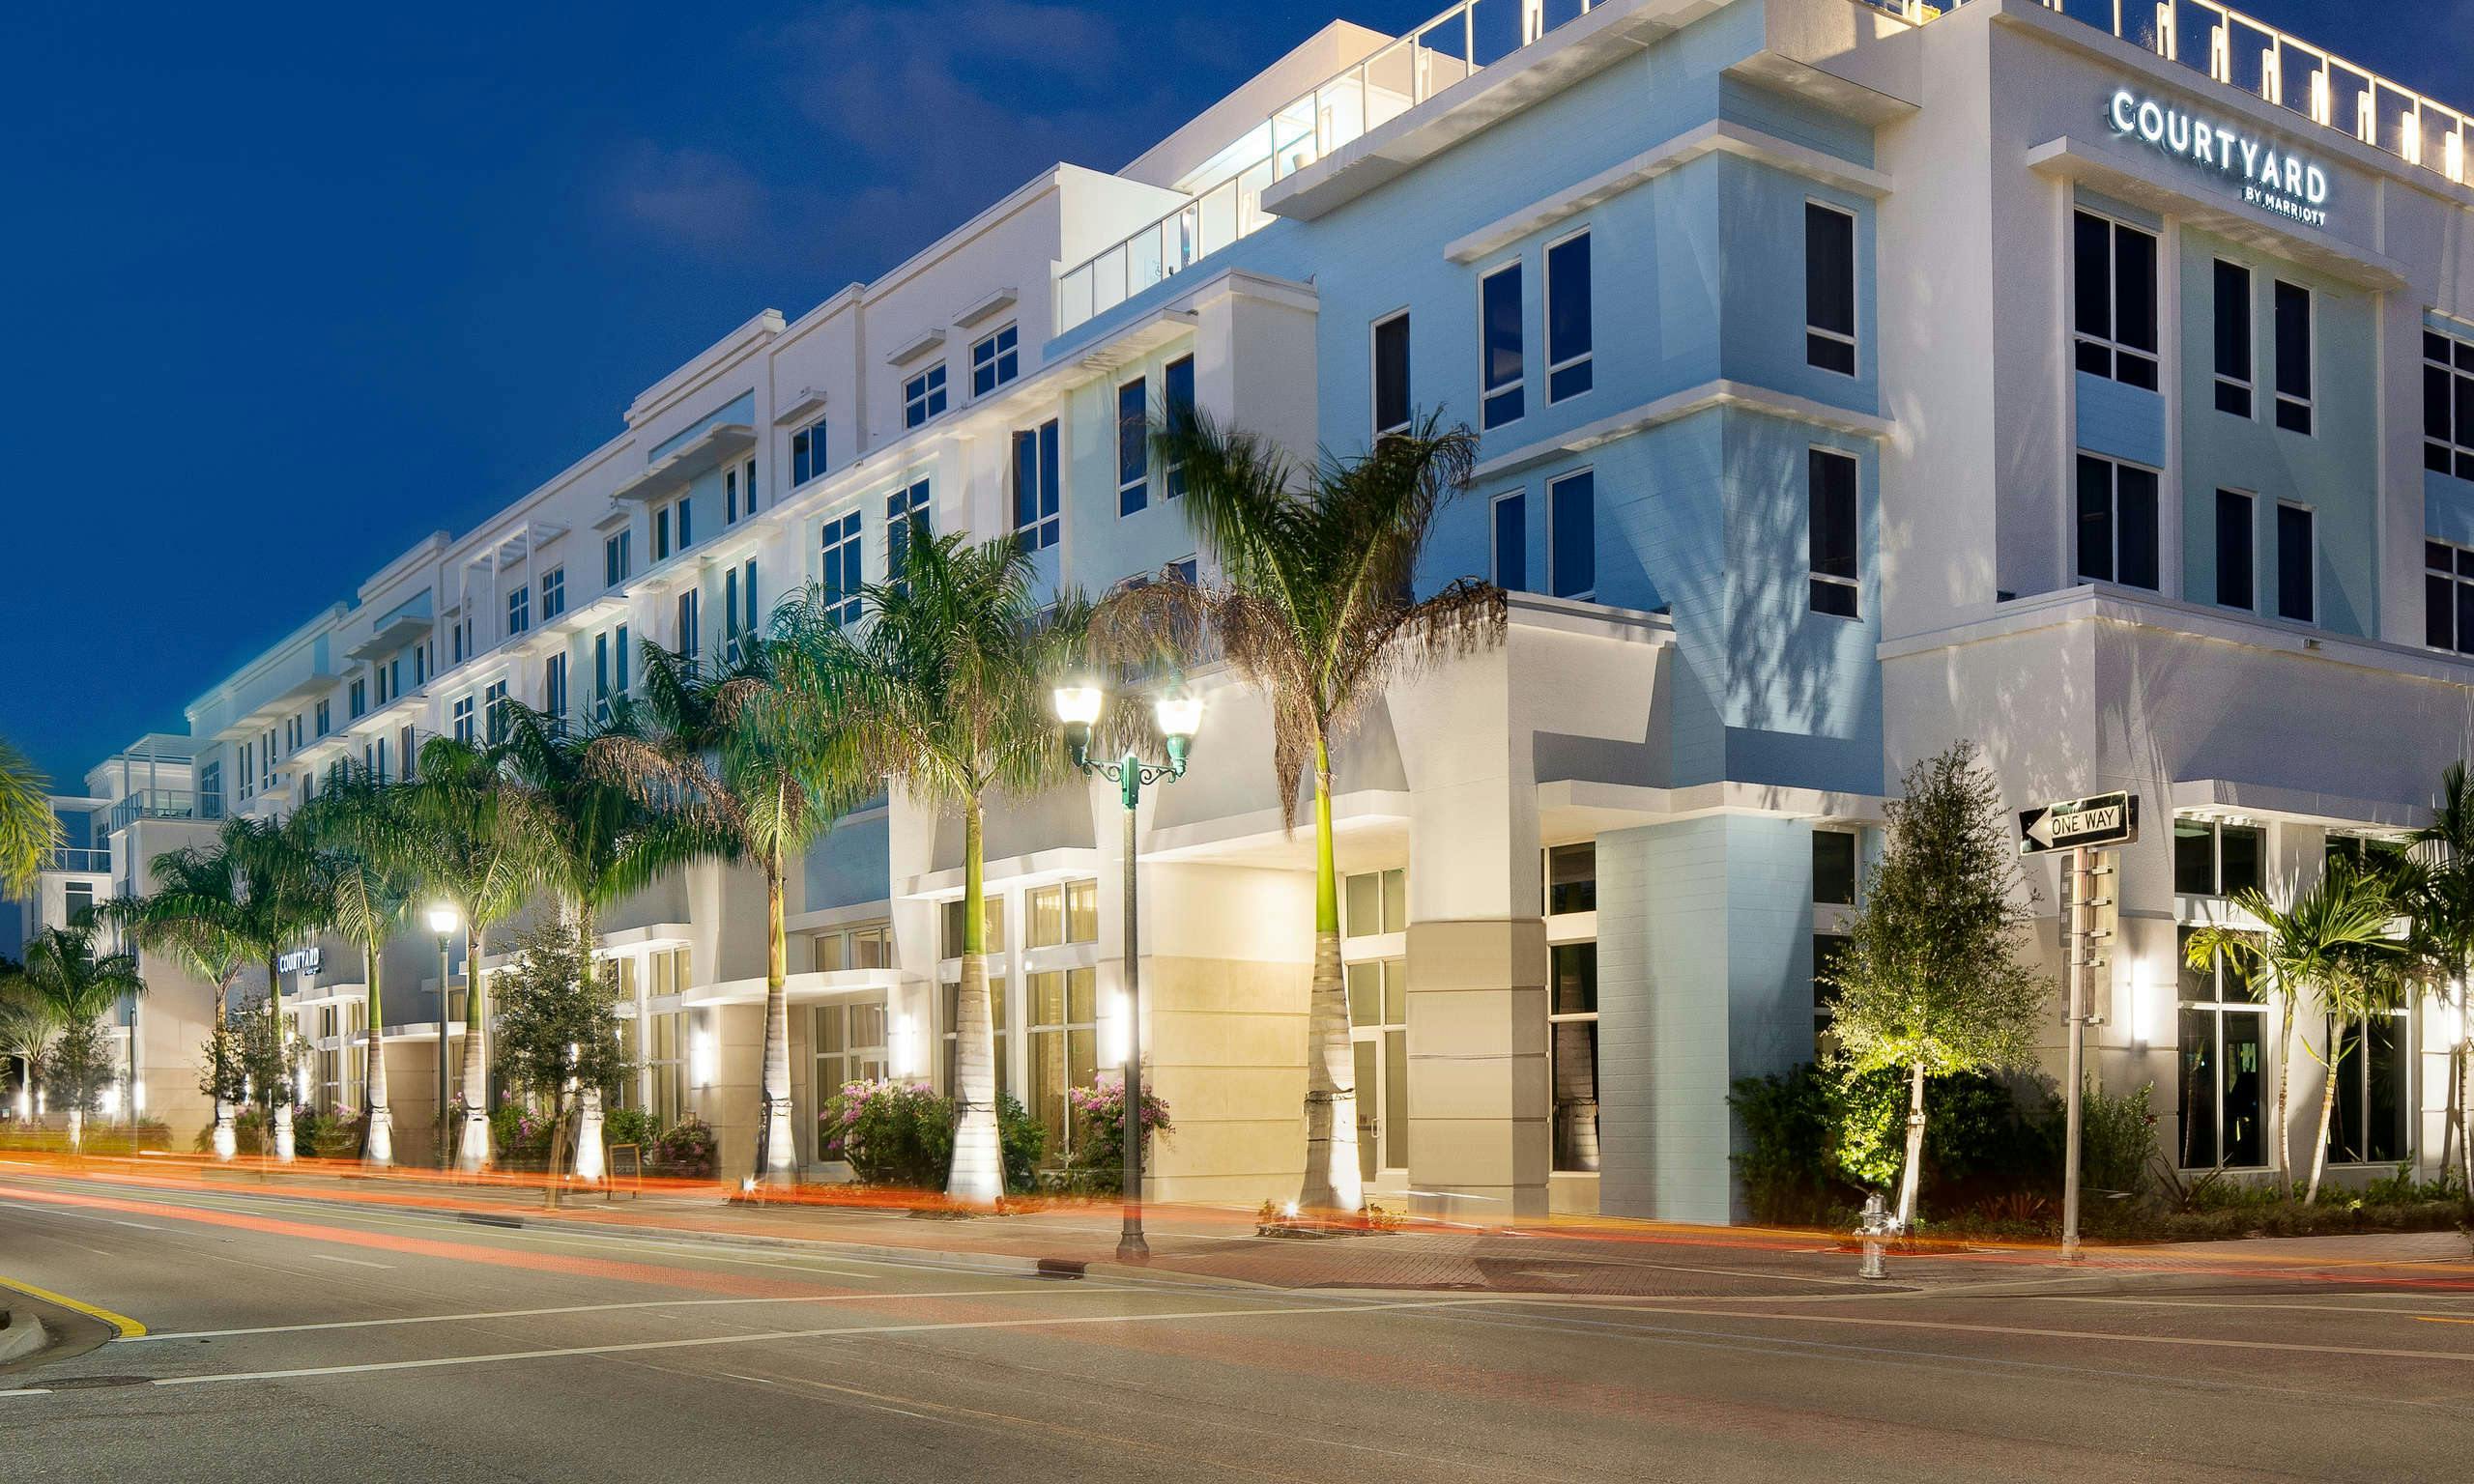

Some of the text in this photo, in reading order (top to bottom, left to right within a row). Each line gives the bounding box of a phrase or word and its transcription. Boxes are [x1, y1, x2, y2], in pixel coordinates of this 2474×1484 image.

[2109, 91, 2326, 203] COURTYARD
[2245, 186, 2326, 226] BY MARRIOTT
[2052, 809, 2115, 836] ONE WAY
[279, 947, 320, 974] COURTYARD
